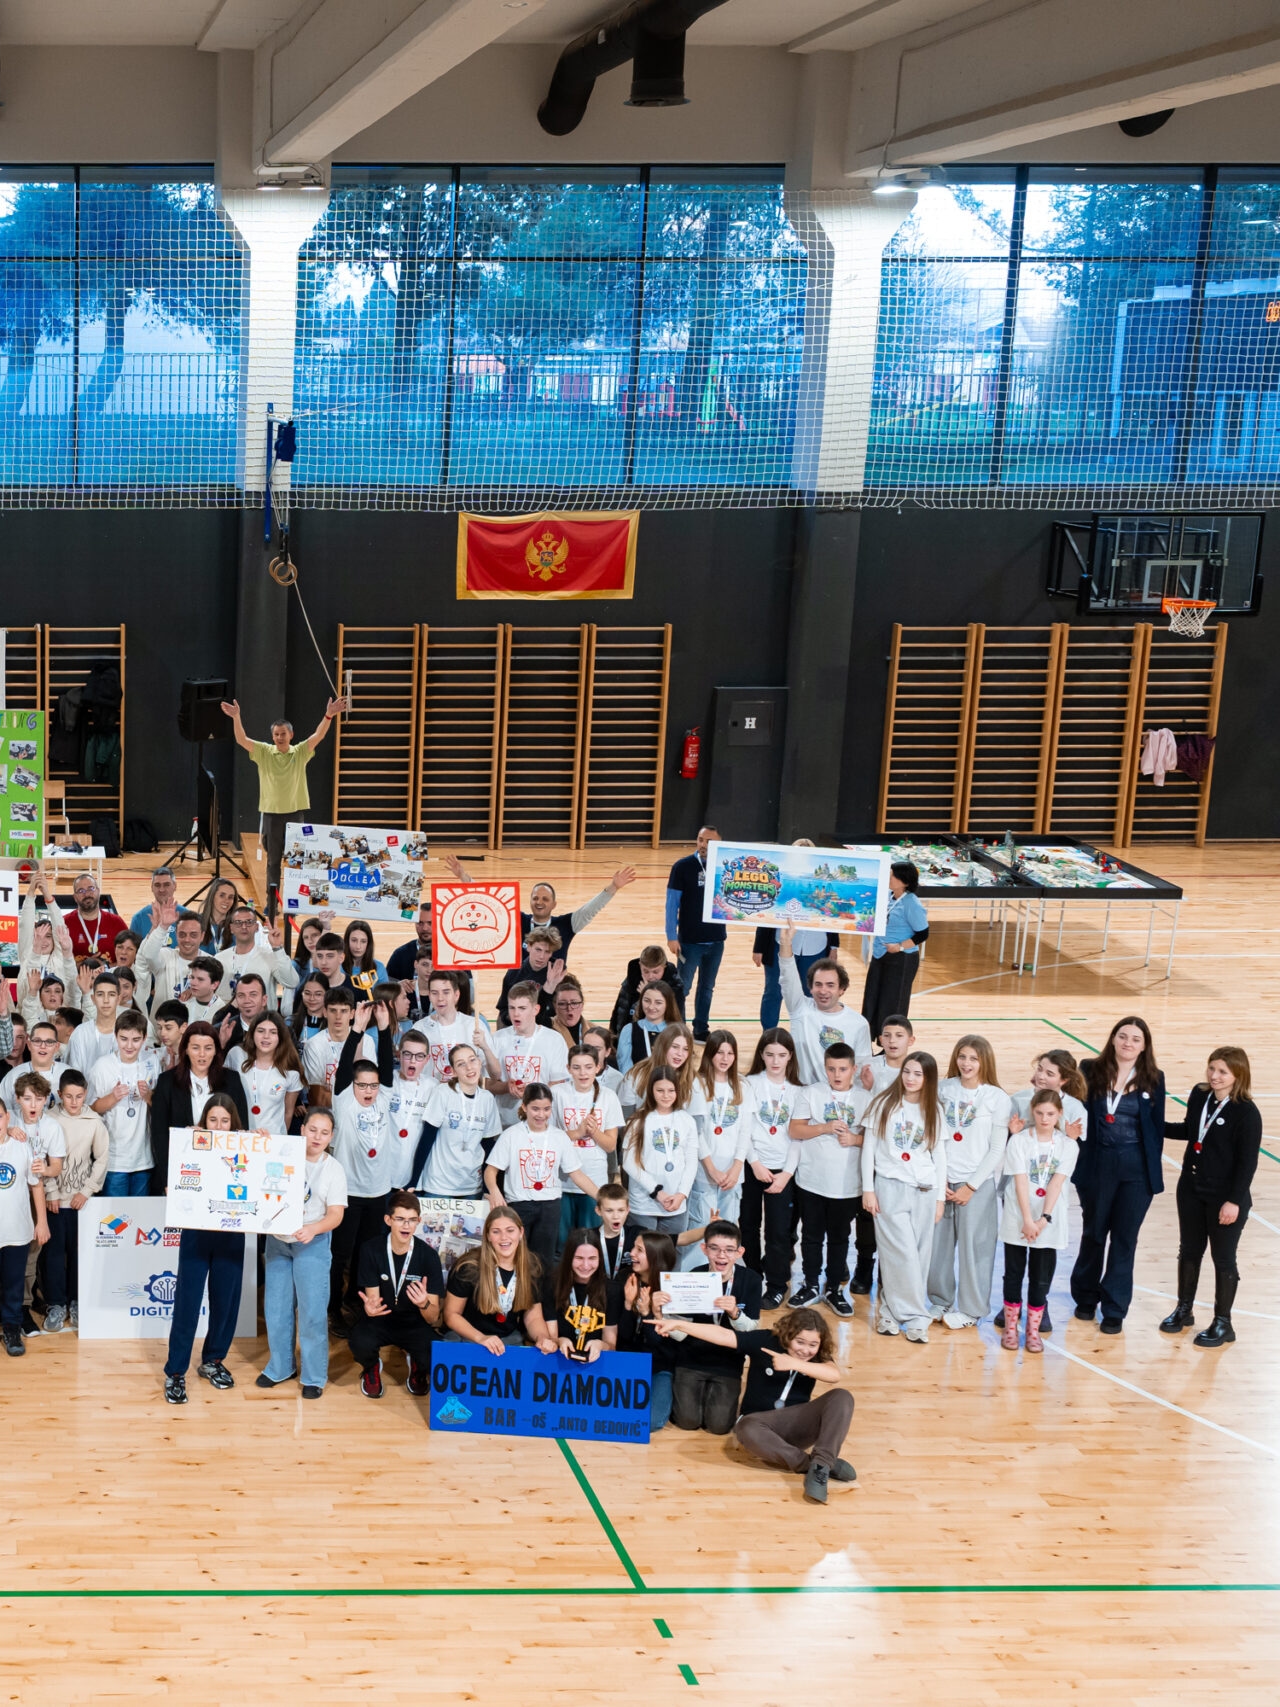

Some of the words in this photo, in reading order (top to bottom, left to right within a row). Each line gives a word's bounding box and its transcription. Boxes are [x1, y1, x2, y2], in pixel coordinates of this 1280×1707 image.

[744, 717, 756, 729] H
[331, 870, 378, 885] DOCLEA
[734, 870, 769, 883] LEGO
[725, 881, 776, 897] MONSTERS
[420, 1200, 475, 1214] NIBBLES
[433, 1363, 521, 1399] OCEAN
[532, 1372, 650, 1410] DIAMOND
[484, 1406, 516, 1427] BAR
[532, 1412, 546, 1429] OŠ
